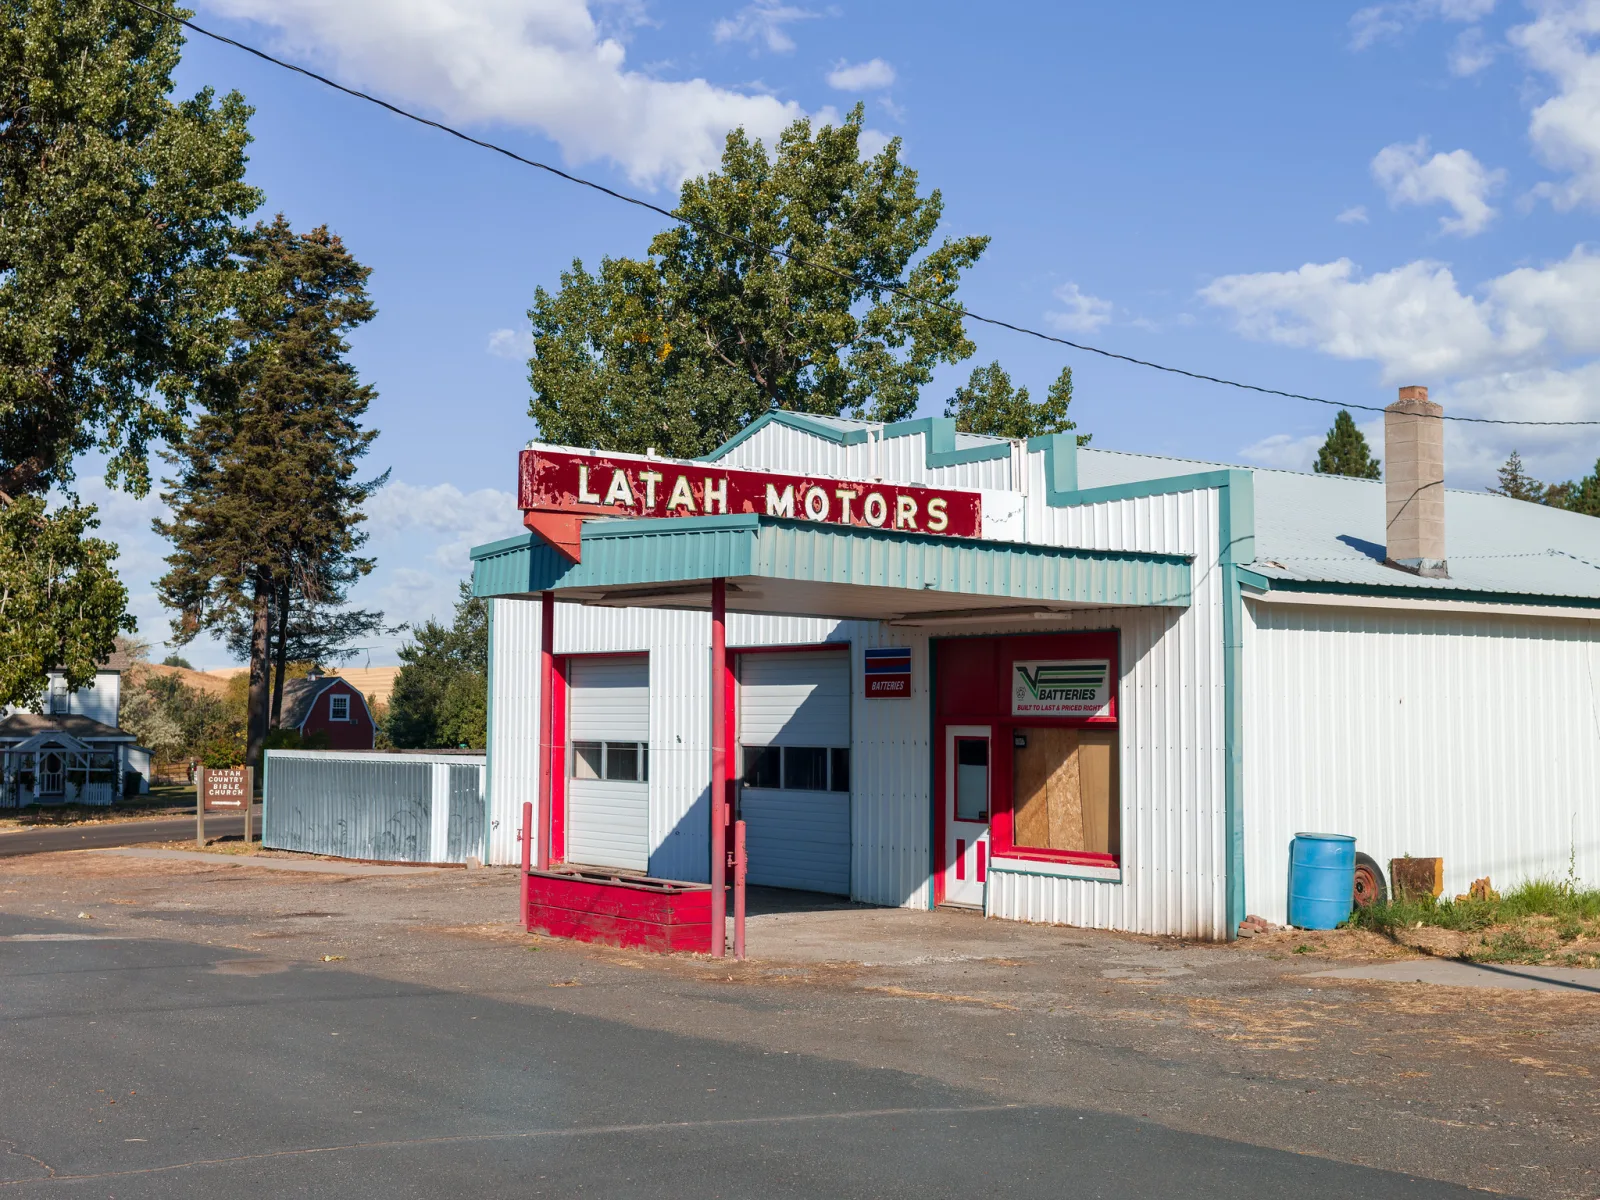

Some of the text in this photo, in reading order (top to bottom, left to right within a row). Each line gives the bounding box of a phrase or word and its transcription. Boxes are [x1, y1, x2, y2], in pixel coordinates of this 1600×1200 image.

[578, 464, 950, 532] LATAH MOTORS
[871, 681, 904, 690] BATTERIES
[1039, 689, 1096, 700] BATTERIES
